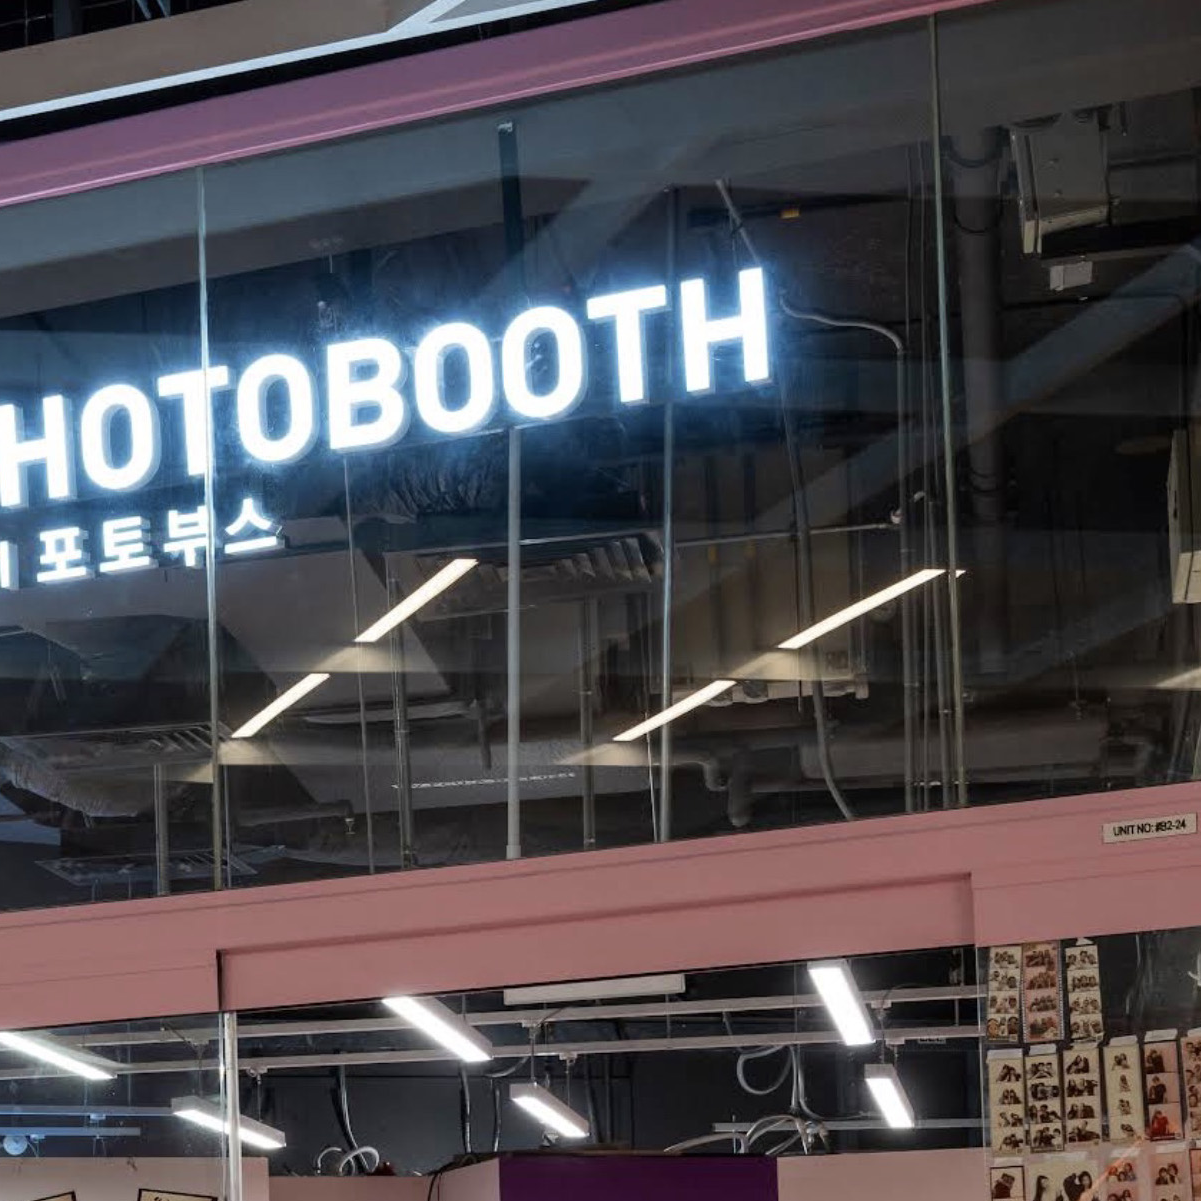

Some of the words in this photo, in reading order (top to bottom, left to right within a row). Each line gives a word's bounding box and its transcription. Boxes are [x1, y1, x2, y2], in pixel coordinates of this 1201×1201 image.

[36, 497, 281, 582] 포토부스
[1113, 825, 1135, 836] UNIT
[1137, 823, 1154, 834] NO:
